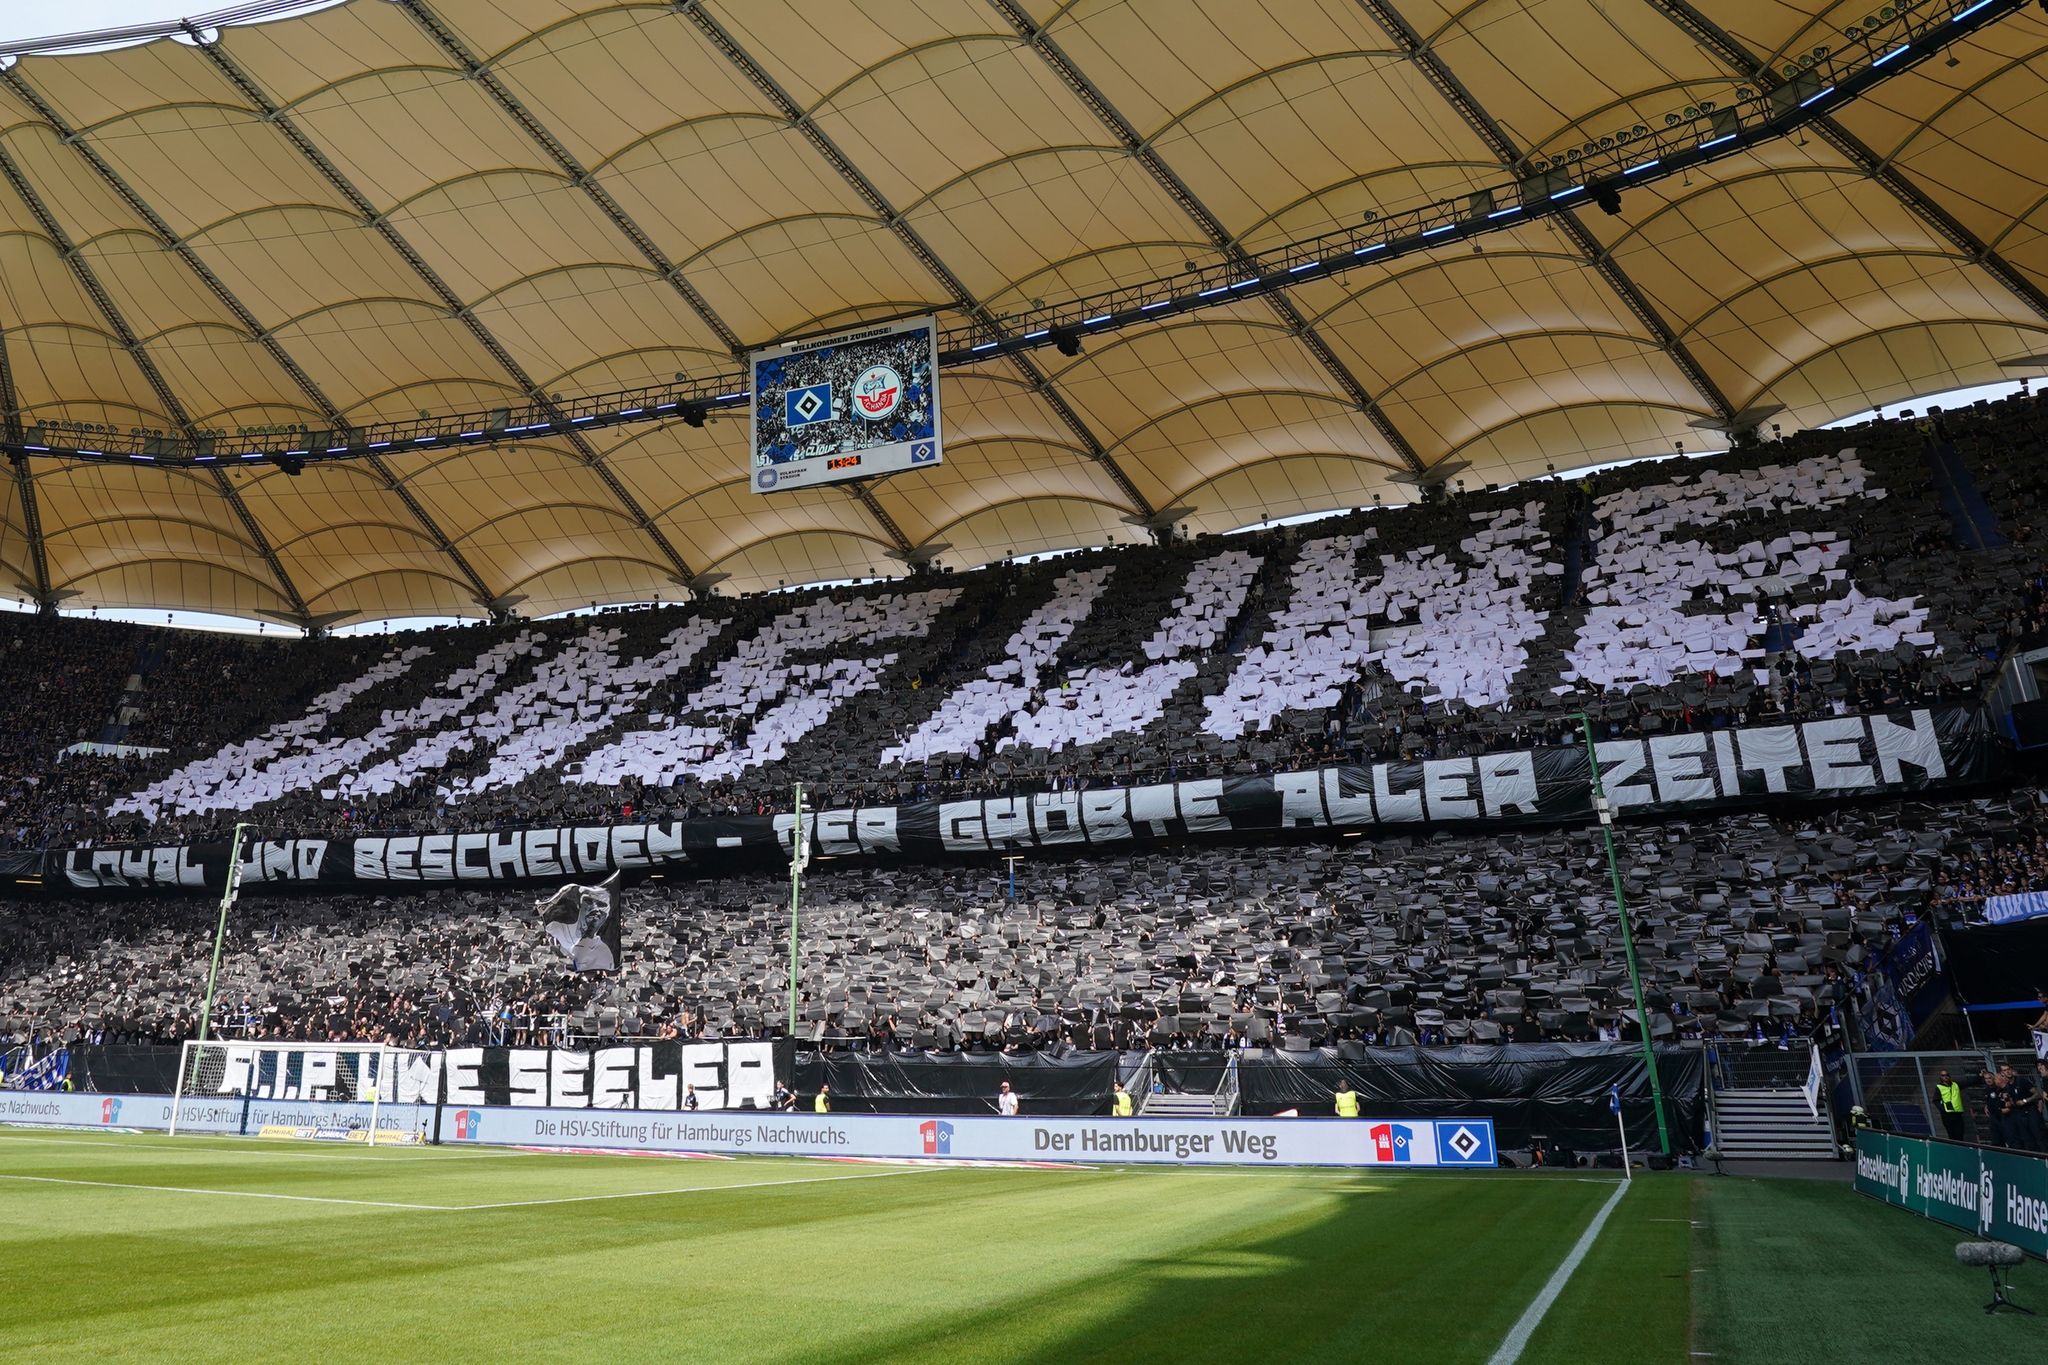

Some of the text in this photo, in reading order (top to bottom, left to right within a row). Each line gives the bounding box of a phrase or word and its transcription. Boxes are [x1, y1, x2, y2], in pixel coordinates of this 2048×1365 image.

[791, 327, 892, 353] WILLKOMMEN ZUHAUSE!
[830, 456, 858, 470] 13:24
[234, 838, 329, 883] UND
[354, 821, 688, 881] BESCHEIDEN
[772, 806, 902, 856] DER
[1274, 750, 1540, 828] ALLER
[1593, 708, 1947, 805] ZEITEN
[357, 1047, 486, 1106] UWE
[508, 1041, 775, 1111] SEELER
[8, 1100, 62, 1116] Nachwuchs.
[182, 1105, 249, 1125] HSV-Stiftun
[252, 1108, 270, 1125] für
[271, 1111, 329, 1129] Hamburgs
[295, 1129, 313, 1139] BET
[349, 1131, 365, 1141] BET
[371, 1132, 401, 1141] DMIRAL
[535, 1119, 851, 1146] Die HSV-Stiftung für Hamburgs Nachwuchs.
[1034, 1128, 1278, 1160] Der Hamburger Weg
[1857, 1149, 1900, 1188] HanseMerkur
[1916, 1163, 1979, 1212] HanseMerkur
[2007, 1183, 2048, 1235] Hanse
